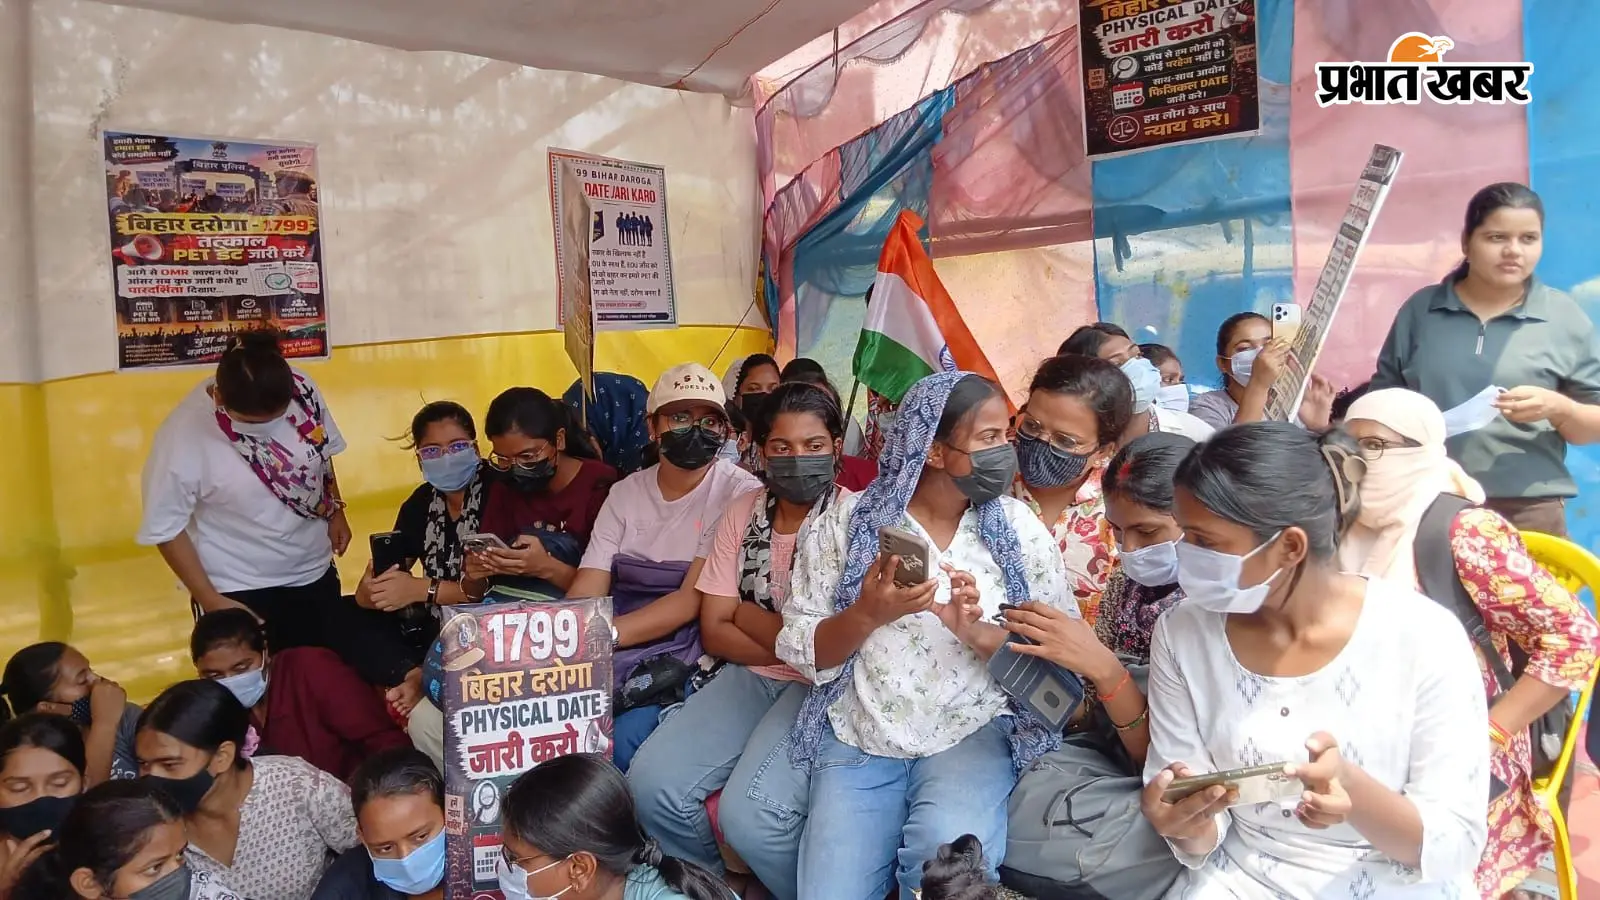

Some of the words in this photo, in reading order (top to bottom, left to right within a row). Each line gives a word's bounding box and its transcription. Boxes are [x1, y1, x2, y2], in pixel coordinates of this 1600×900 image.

[1101, 0, 1159, 21] बिहार
[1102, 6, 1189, 36] PHYSICAL
[1108, 28, 1160, 54] जारी
[1165, 14, 1214, 41] करो
[1144, 61, 1163, 72] कोई
[1195, 50, 1211, 61] नहीं
[1175, 48, 1187, 56] हम
[1152, 71, 1194, 85] साथ-साथ
[1196, 66, 1225, 76] आयोग
[1149, 81, 1198, 97] फिजिकल
[1201, 75, 1229, 88] DATE
[1167, 94, 1185, 104] जारी
[1143, 114, 1159, 123] हम
[1162, 109, 1185, 118] लोग
[1188, 105, 1200, 114] के
[1203, 102, 1226, 112] साथ
[1144, 120, 1187, 136] न्याय
[192, 160, 218, 169] बिहार
[221, 162, 246, 172] पुलिस
[574, 168, 588, 177] 99
[591, 170, 618, 180] BIHAR
[621, 175, 652, 186] DAROGA
[584, 183, 609, 198] DATE
[611, 185, 630, 200] JARI
[632, 188, 656, 203] KARO
[126, 214, 186, 232] बिहार
[190, 215, 248, 232] दरोगा
[263, 219, 308, 232] 1799
[197, 236, 268, 247] तत्काल
[173, 249, 209, 261] PET
[216, 248, 243, 260] डेट
[248, 247, 278, 259] जारी
[281, 246, 306, 258] करें
[487, 609, 579, 663] 1799
[460, 667, 524, 703] बिहार
[530, 658, 593, 696] दरोगा
[462, 701, 552, 735] PHYSICAL
[558, 693, 600, 721] DATE
[468, 730, 524, 773] जारी
[529, 723, 579, 762] करो
